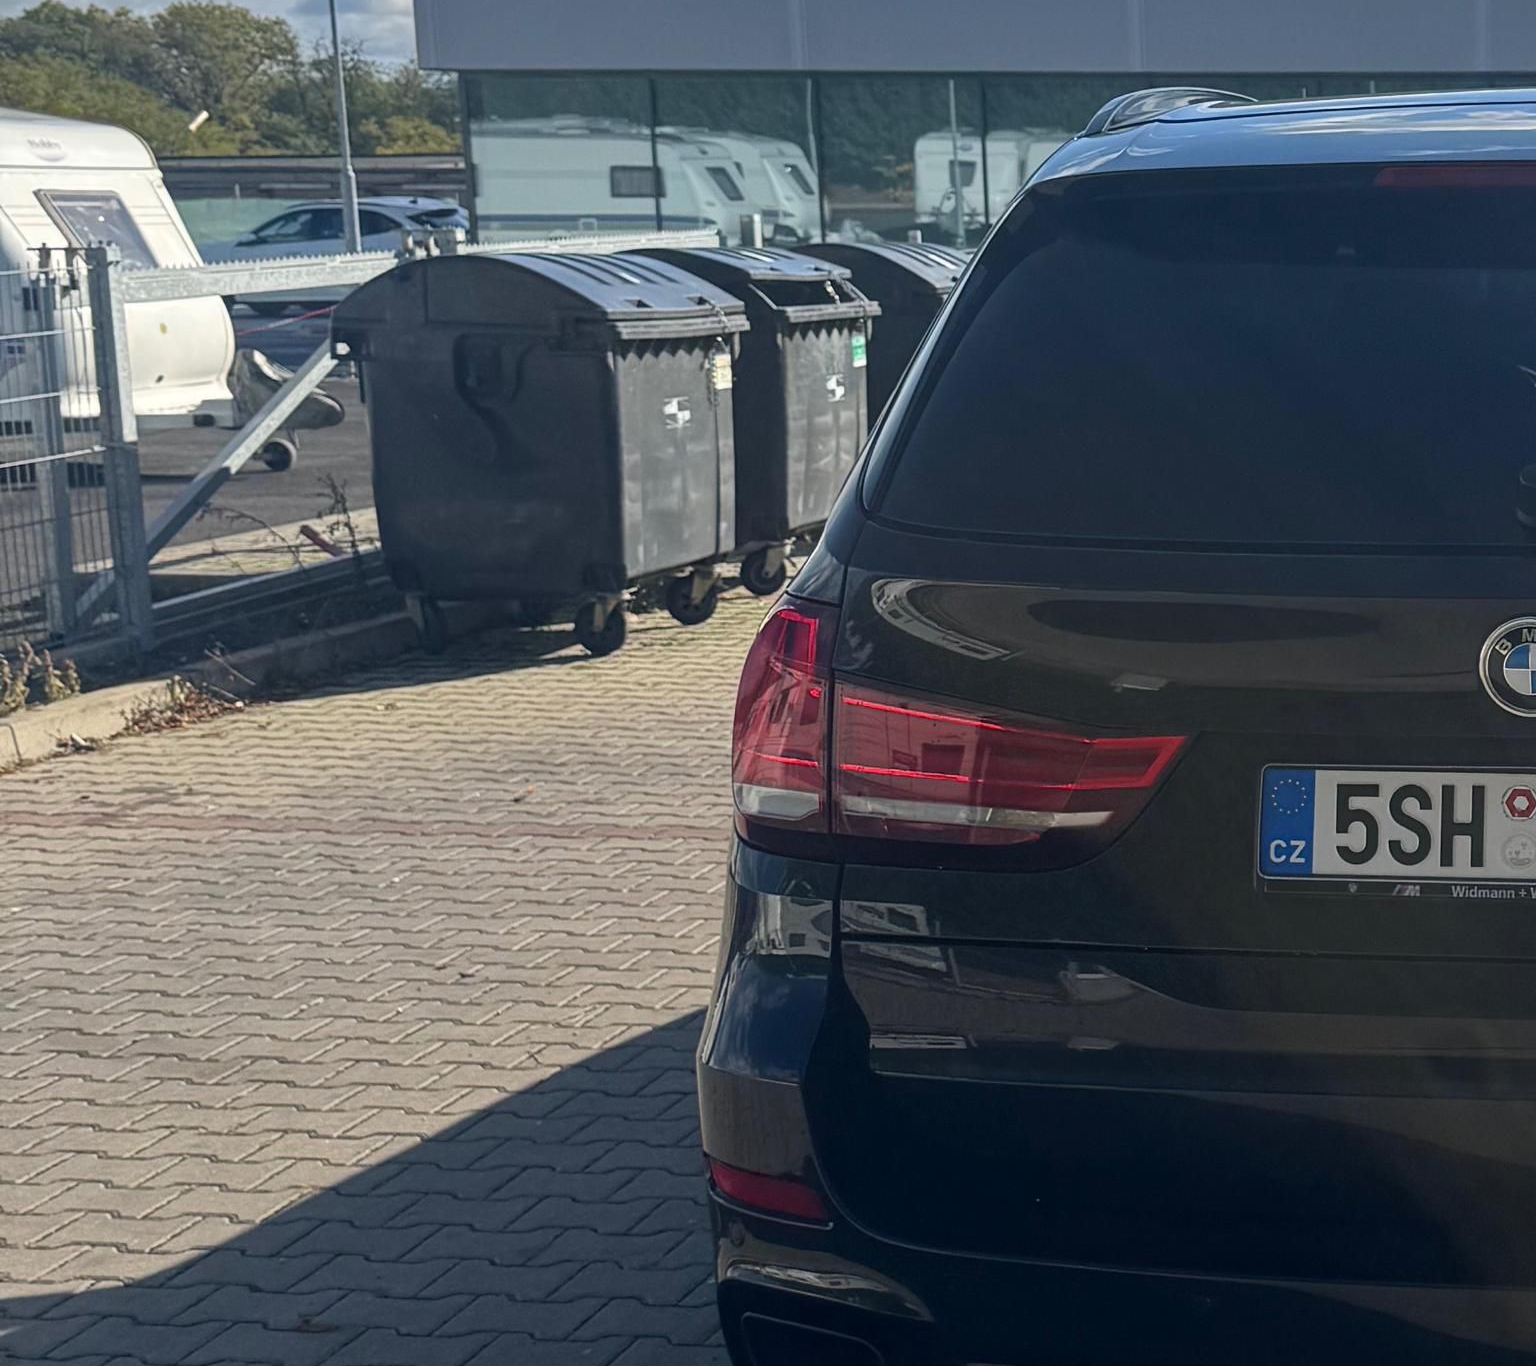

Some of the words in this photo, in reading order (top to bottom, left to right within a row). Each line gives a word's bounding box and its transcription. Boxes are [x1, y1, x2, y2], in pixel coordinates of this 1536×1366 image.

[1335, 783, 1486, 867] 5SH
[1269, 839, 1306, 864] CZ
[1451, 885, 1515, 899] Widmann
